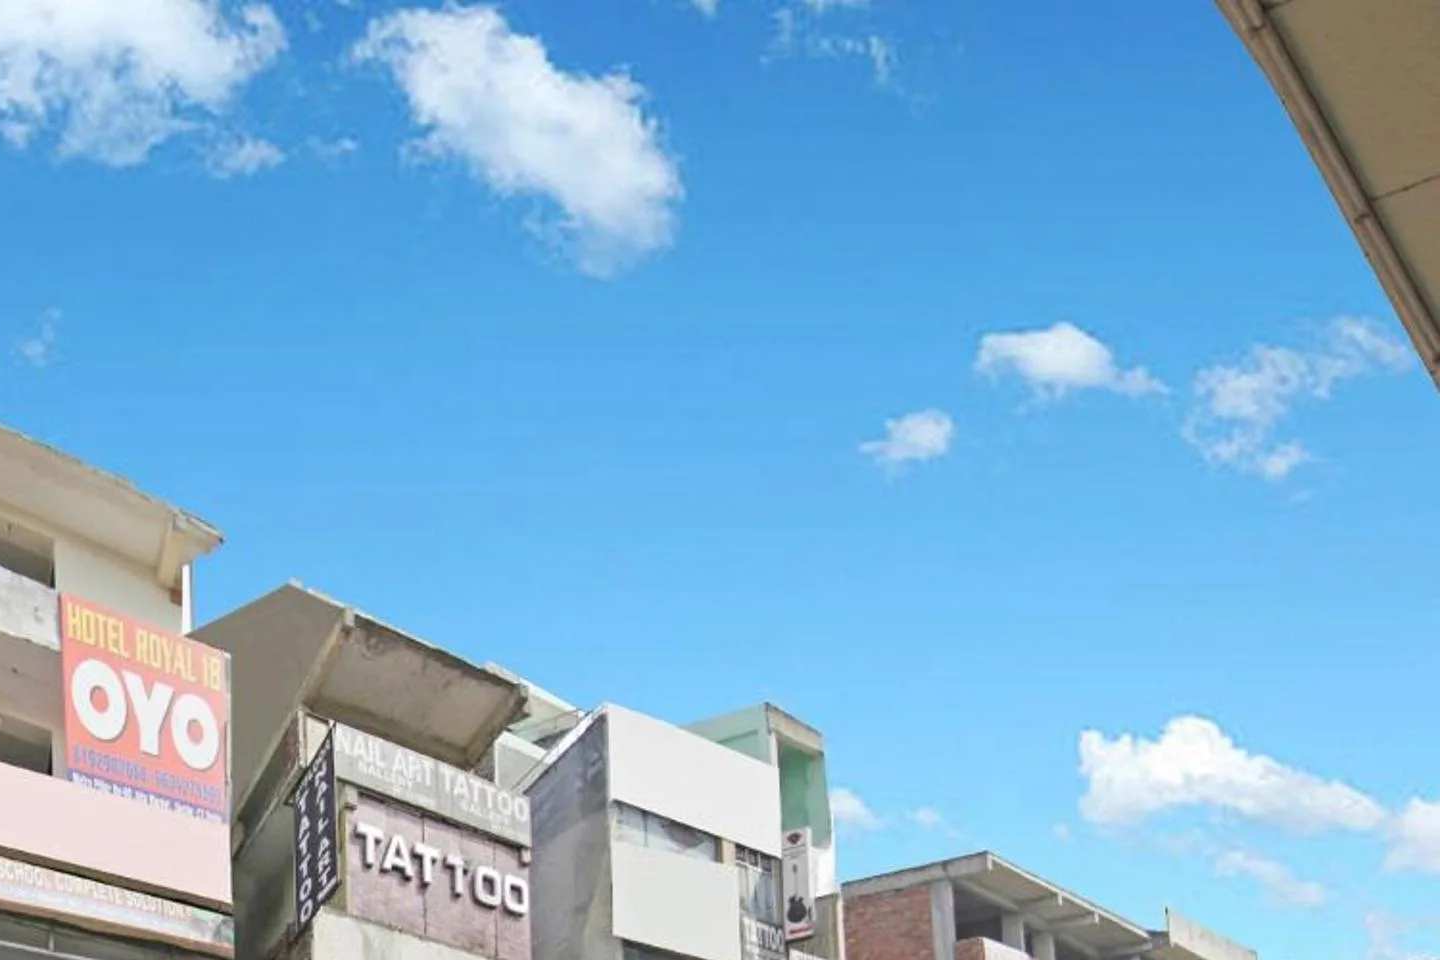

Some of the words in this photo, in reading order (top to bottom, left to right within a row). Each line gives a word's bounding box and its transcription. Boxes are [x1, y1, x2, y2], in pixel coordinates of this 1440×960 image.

[66, 601, 131, 660] HOTEL
[135, 629, 198, 683] ROYAL
[201, 649, 222, 692] 18
[70, 658, 221, 771] OYO
[335, 727, 388, 768] NAIL
[393, 751, 435, 787] ART
[438, 767, 529, 823] TATTOO
[298, 788, 314, 922] TATTOO
[354, 821, 529, 915] TATTOO
